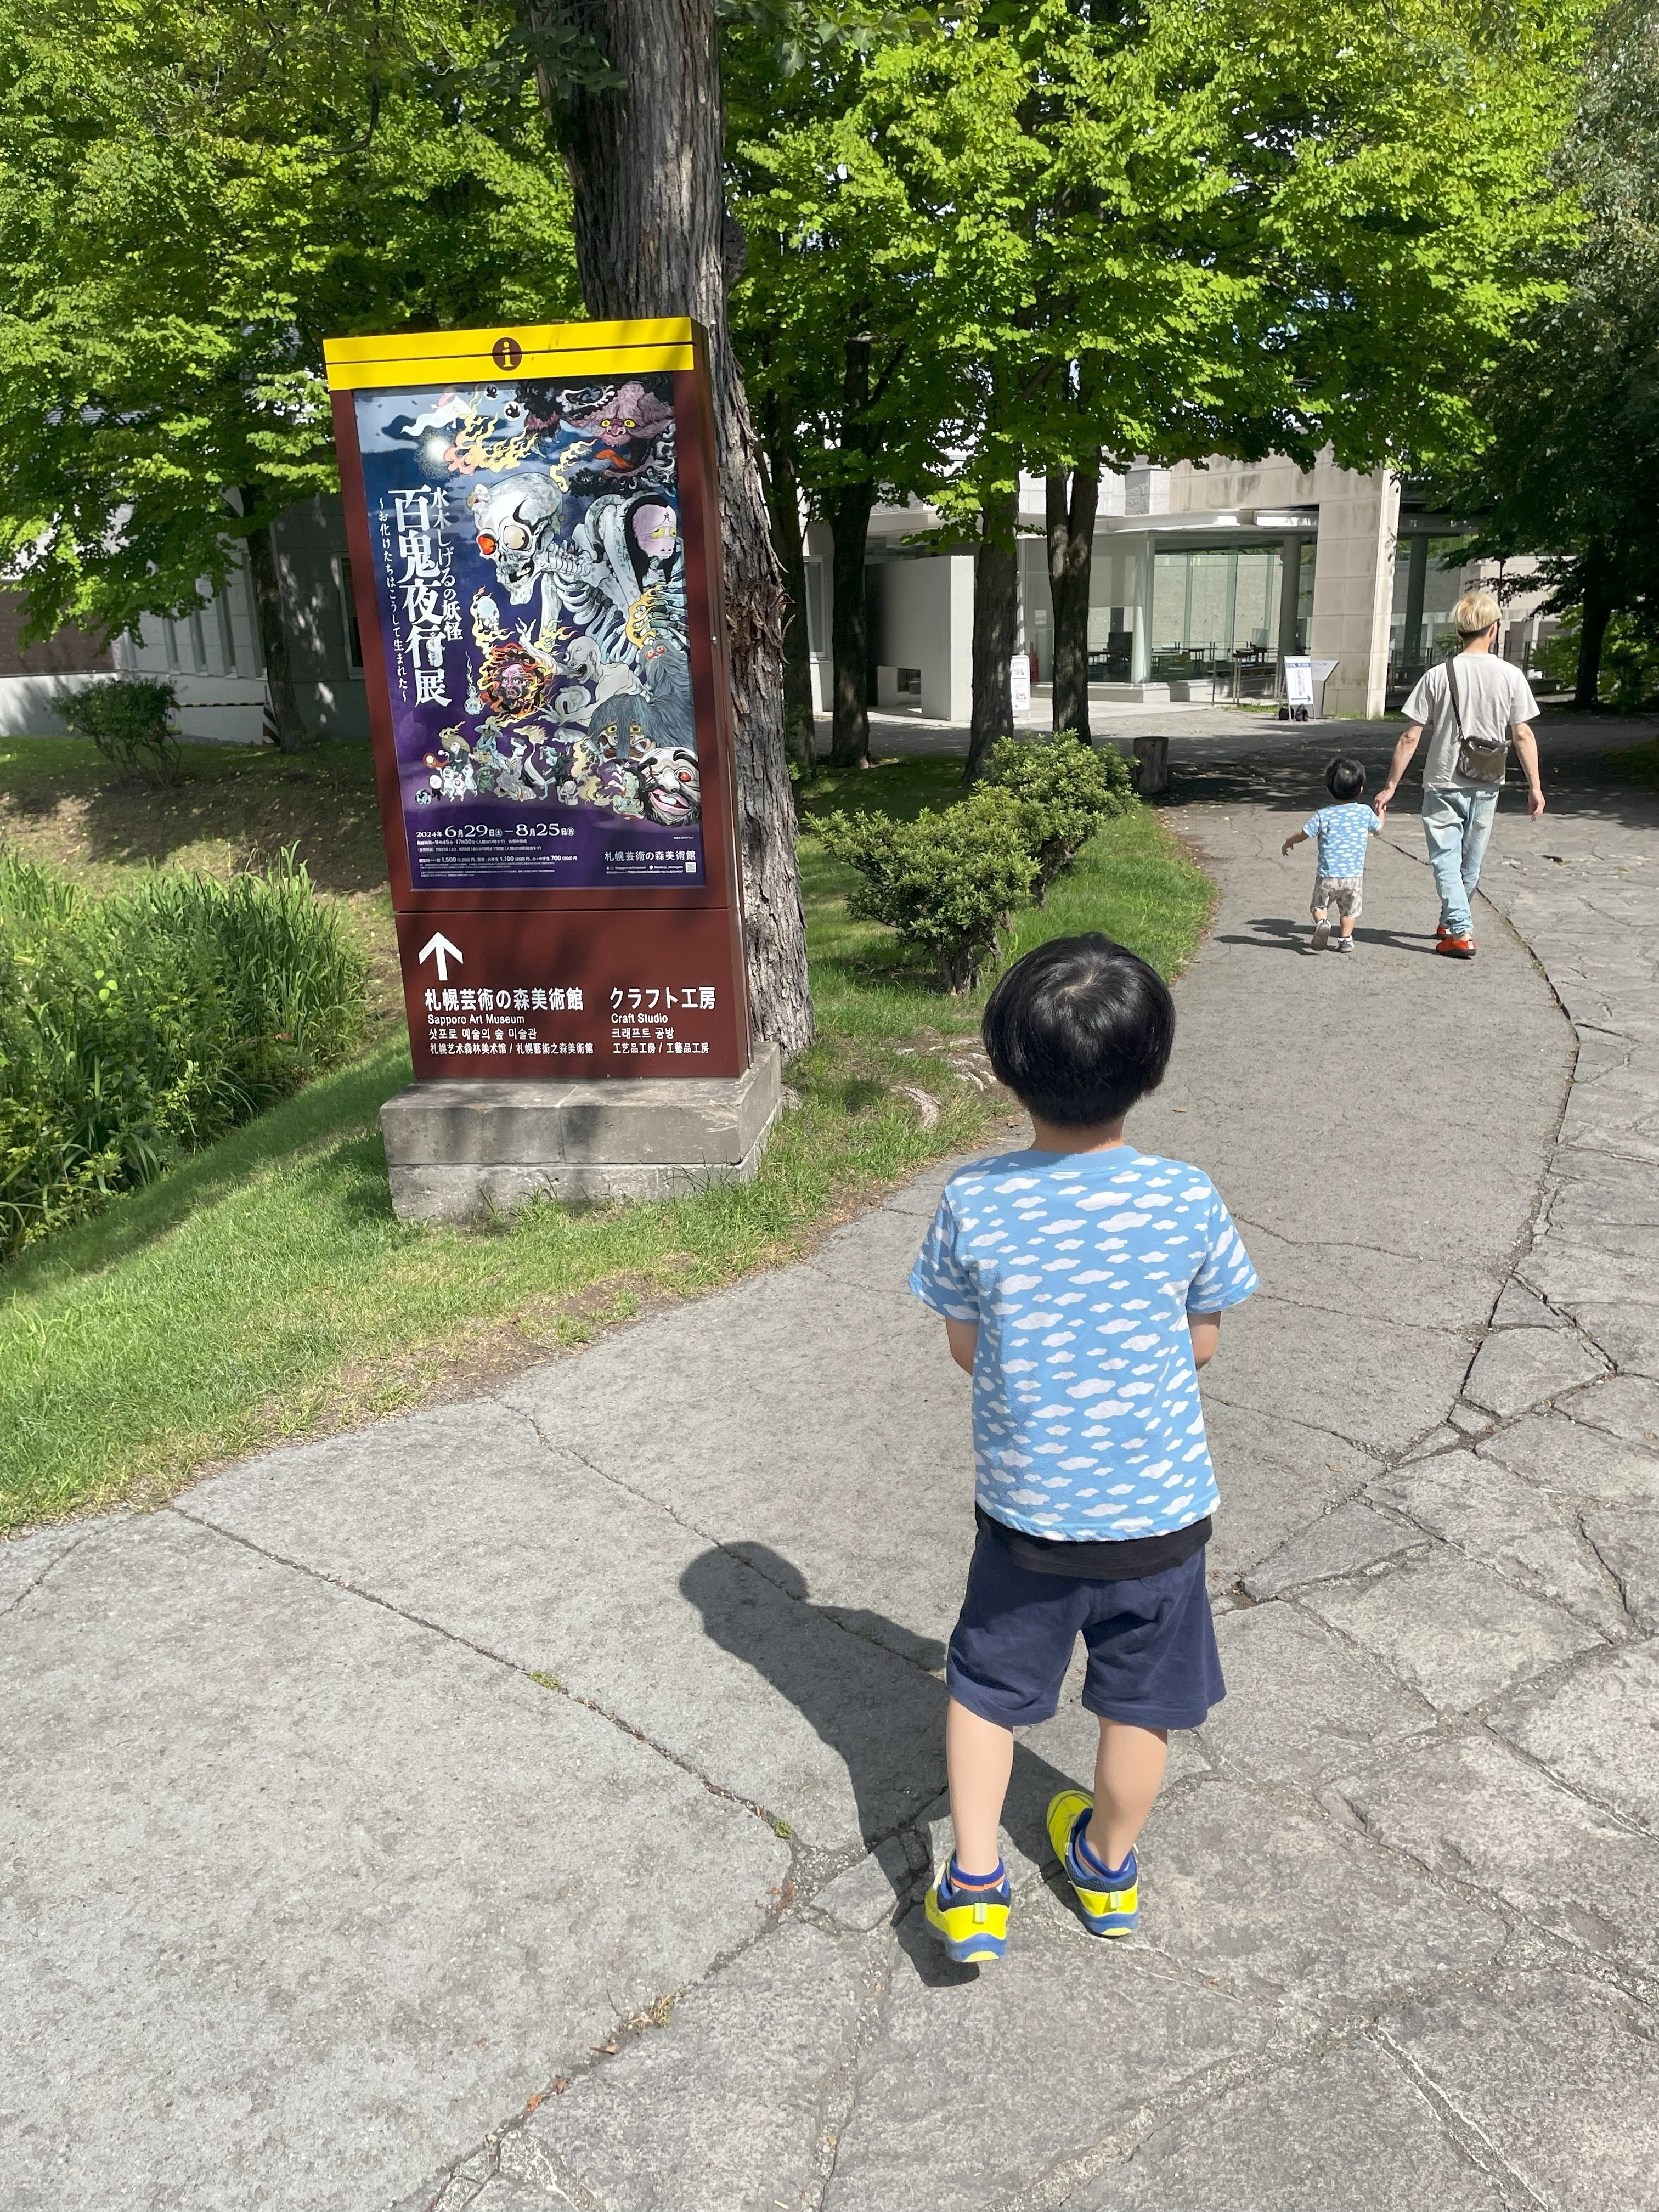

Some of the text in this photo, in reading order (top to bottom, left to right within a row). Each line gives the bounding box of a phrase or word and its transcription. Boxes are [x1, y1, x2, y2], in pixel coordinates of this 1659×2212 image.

[430, 487, 463, 641] 水木しげるの妖怪
[388, 484, 452, 707] 百鬼夜行展
[605, 850, 696, 862] 札幌芸術の森美術館
[425, 988, 583, 1011] 札幌芸術の森美術館
[610, 986, 716, 1009] クラフト工房
[427, 1014, 525, 1026] Sapporo Art Museum
[611, 1013, 668, 1023] Craft Studio
[428, 1028, 537, 1040] 삿포로 예술의 숲 미술관
[612, 1026, 674, 1040] 크래프트 공방
[430, 1042, 506, 1054] 札幌艺术森林美术馆
[516, 1042, 594, 1054] 札幌藝術之森美術館
[613, 1042, 656, 1054] 工艺品工房
[667, 1042, 709, 1054] 工藝品工房
